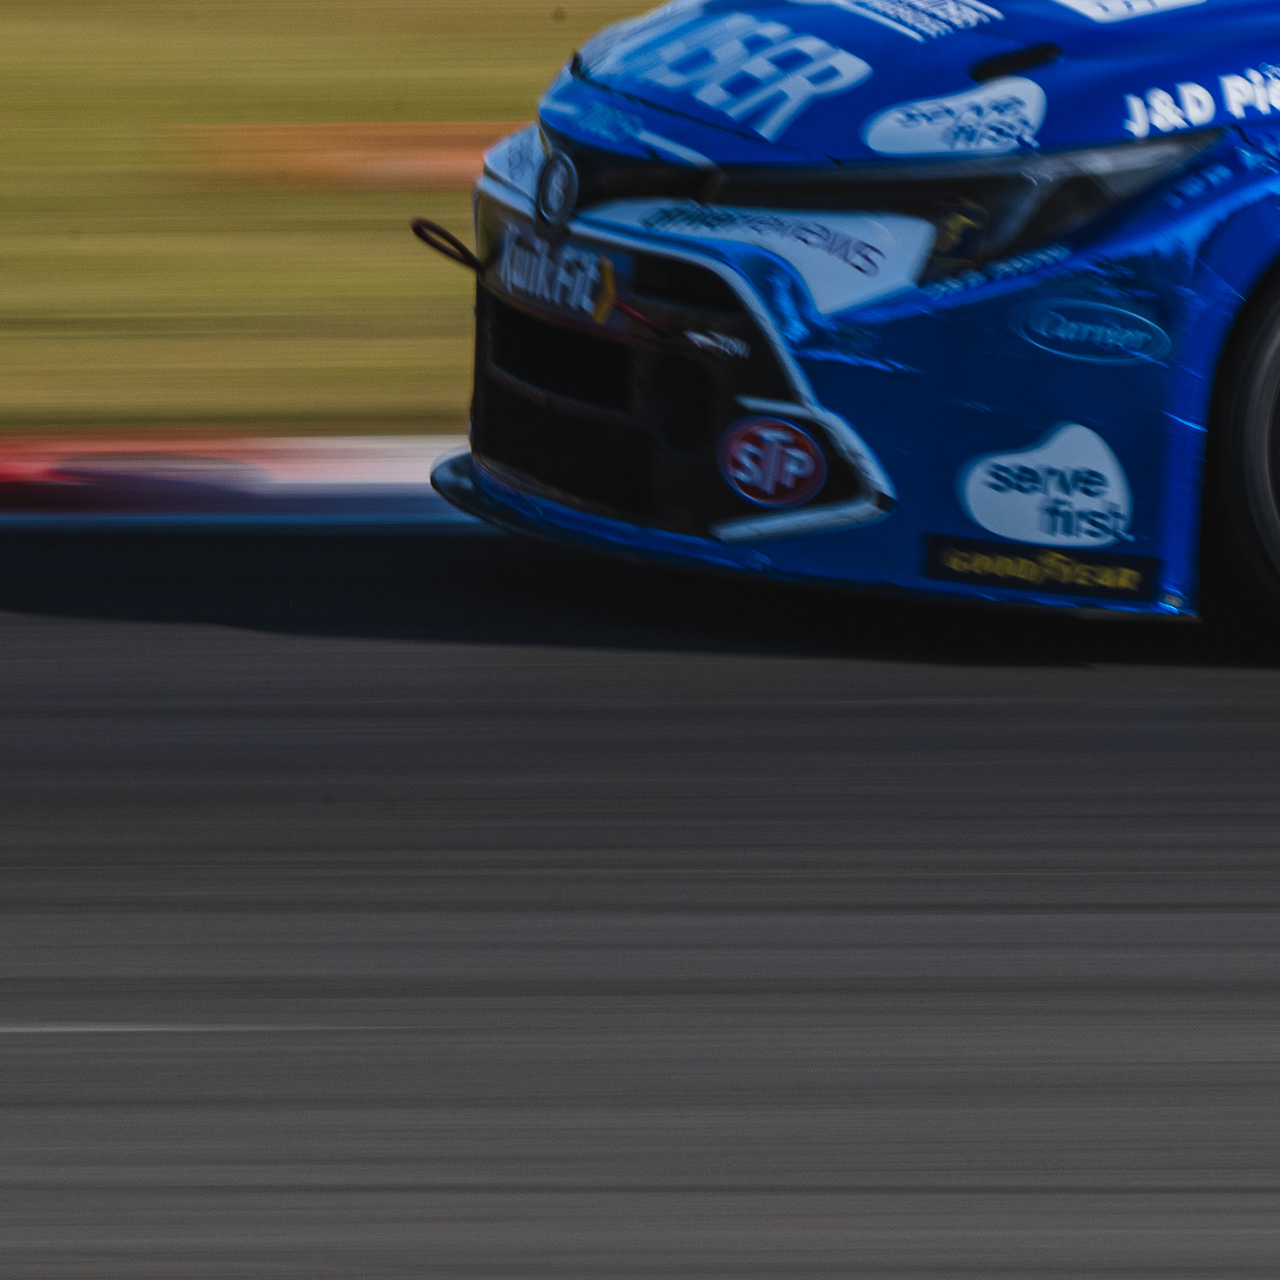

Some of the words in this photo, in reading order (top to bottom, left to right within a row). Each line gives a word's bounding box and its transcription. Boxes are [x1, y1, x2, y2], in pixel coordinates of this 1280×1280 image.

[1122, 81, 1216, 139] J&D
[732, 427, 816, 496] STP
[984, 462, 1110, 499] serve
